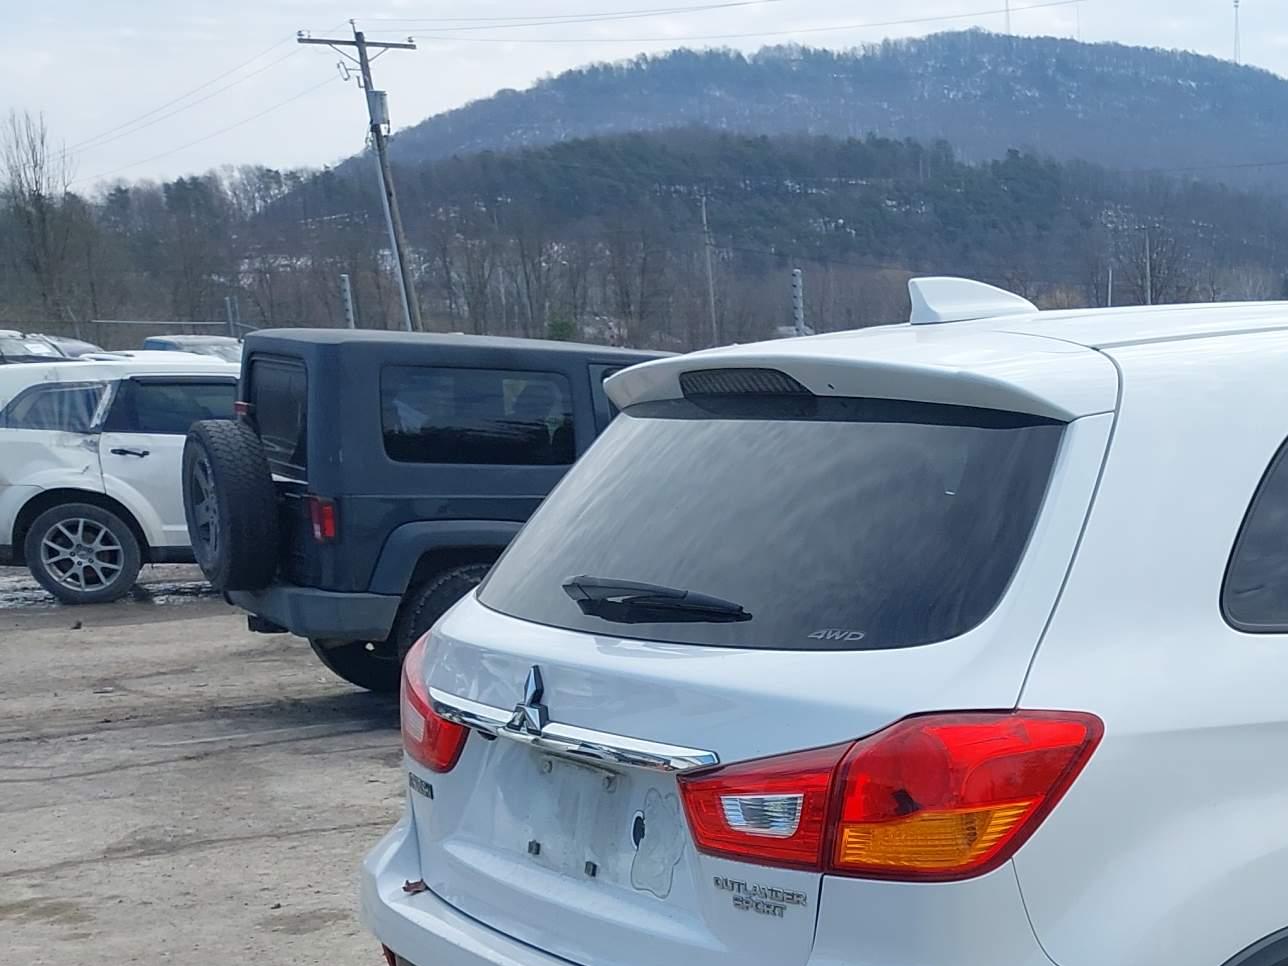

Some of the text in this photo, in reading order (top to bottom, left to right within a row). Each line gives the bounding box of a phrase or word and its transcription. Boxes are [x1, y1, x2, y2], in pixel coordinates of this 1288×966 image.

[807, 629, 865, 641] 4WD
[713, 875, 808, 907] OUTLANDER
[732, 894, 787, 918] SPORT
